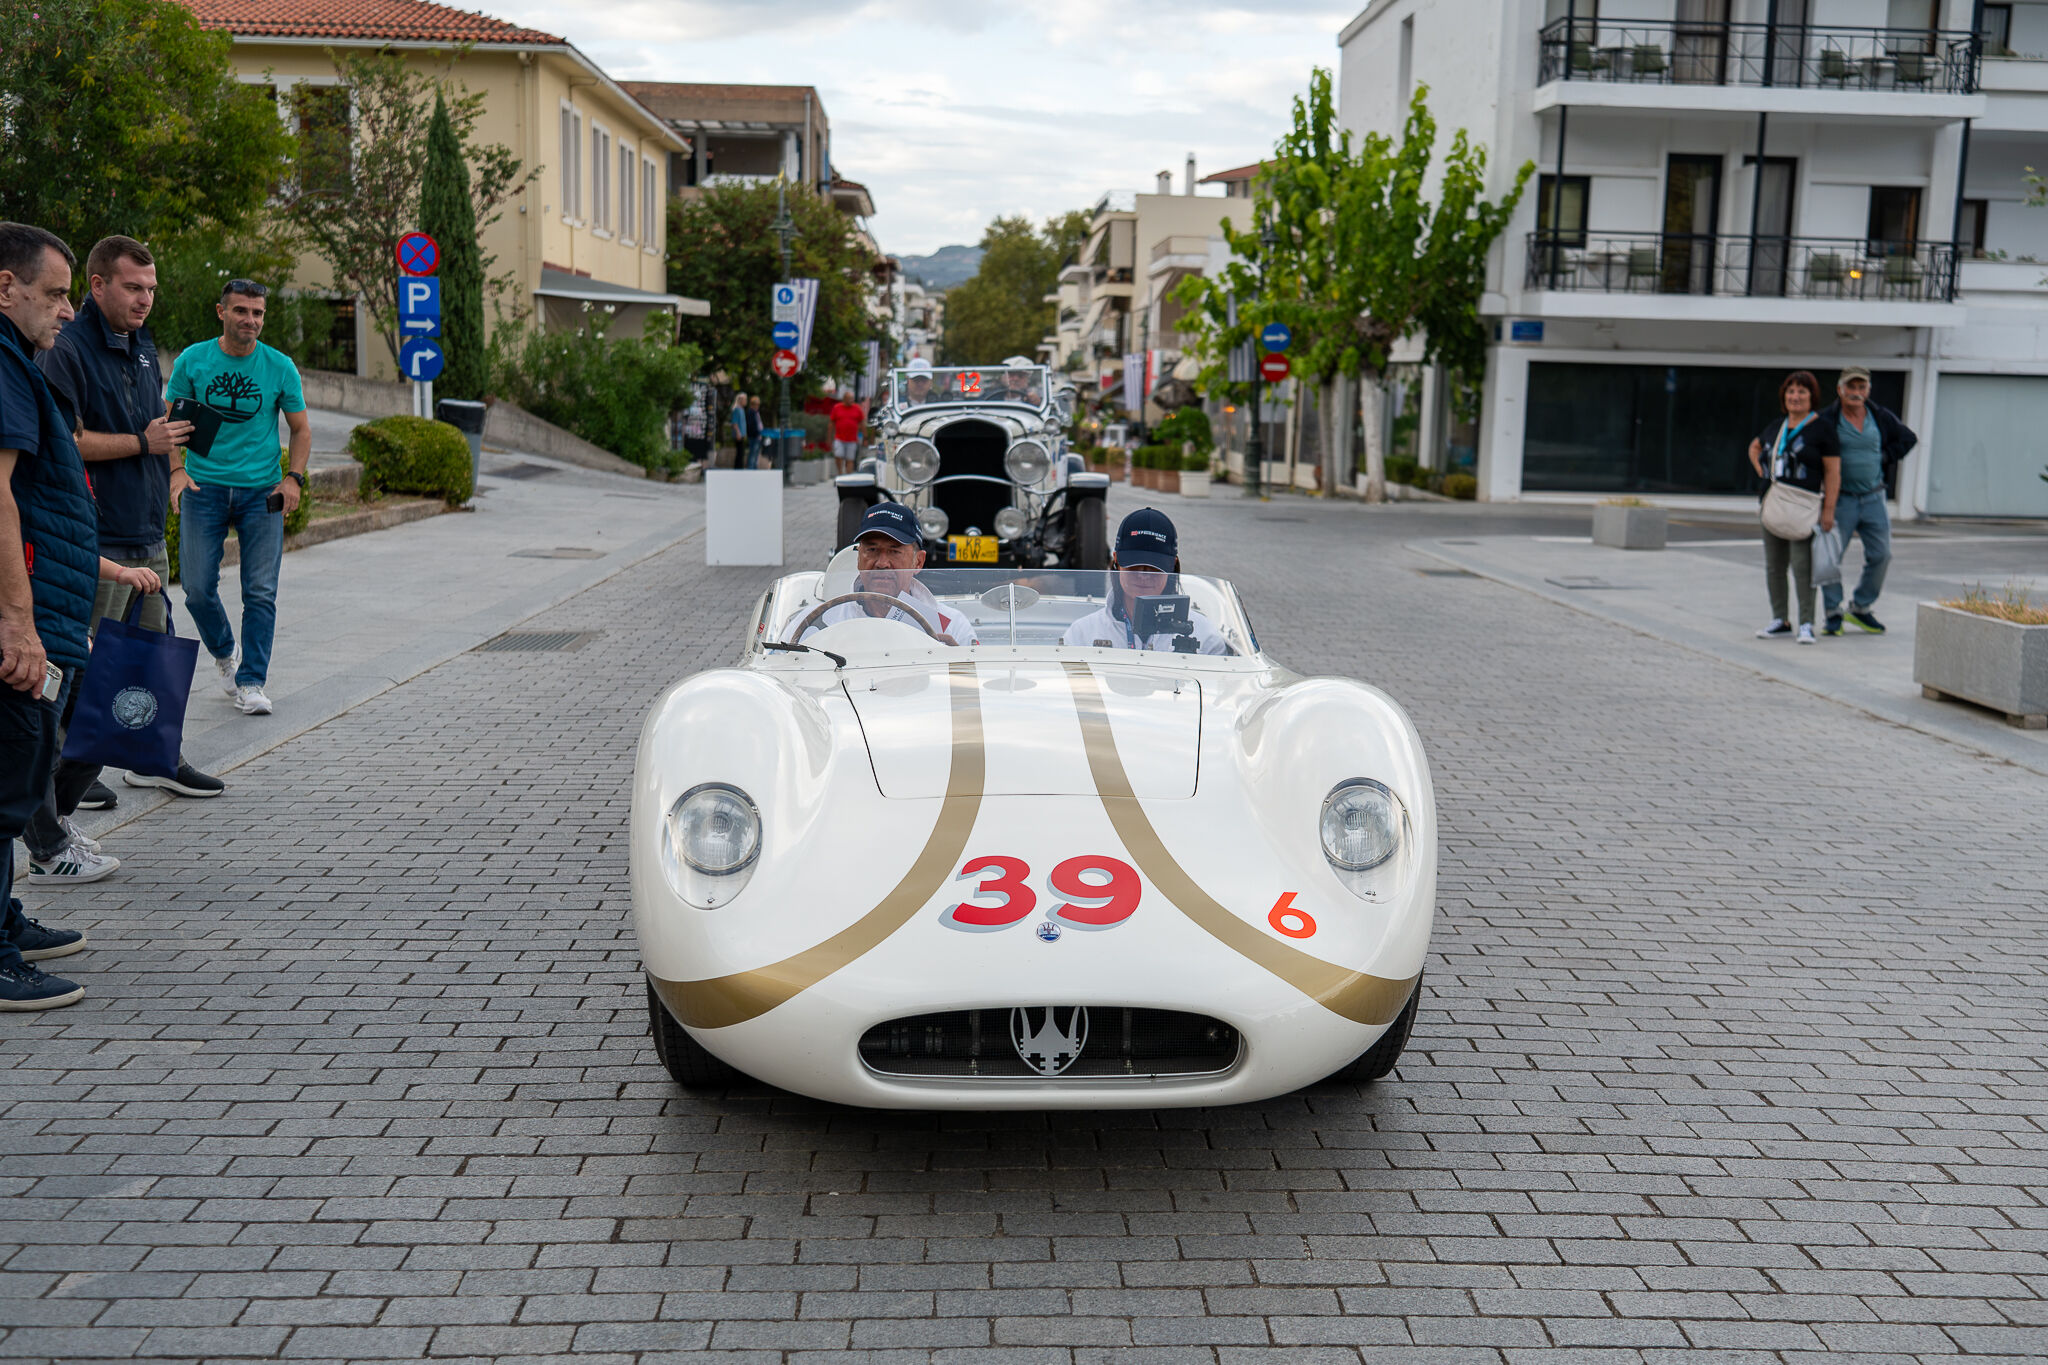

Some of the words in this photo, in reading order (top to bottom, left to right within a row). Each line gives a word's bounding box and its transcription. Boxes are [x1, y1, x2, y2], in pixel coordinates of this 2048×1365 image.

[408, 283, 431, 314] P
[956, 372, 982, 392] 12
[938, 855, 1142, 933] 39
[1268, 892, 1317, 939] 6
